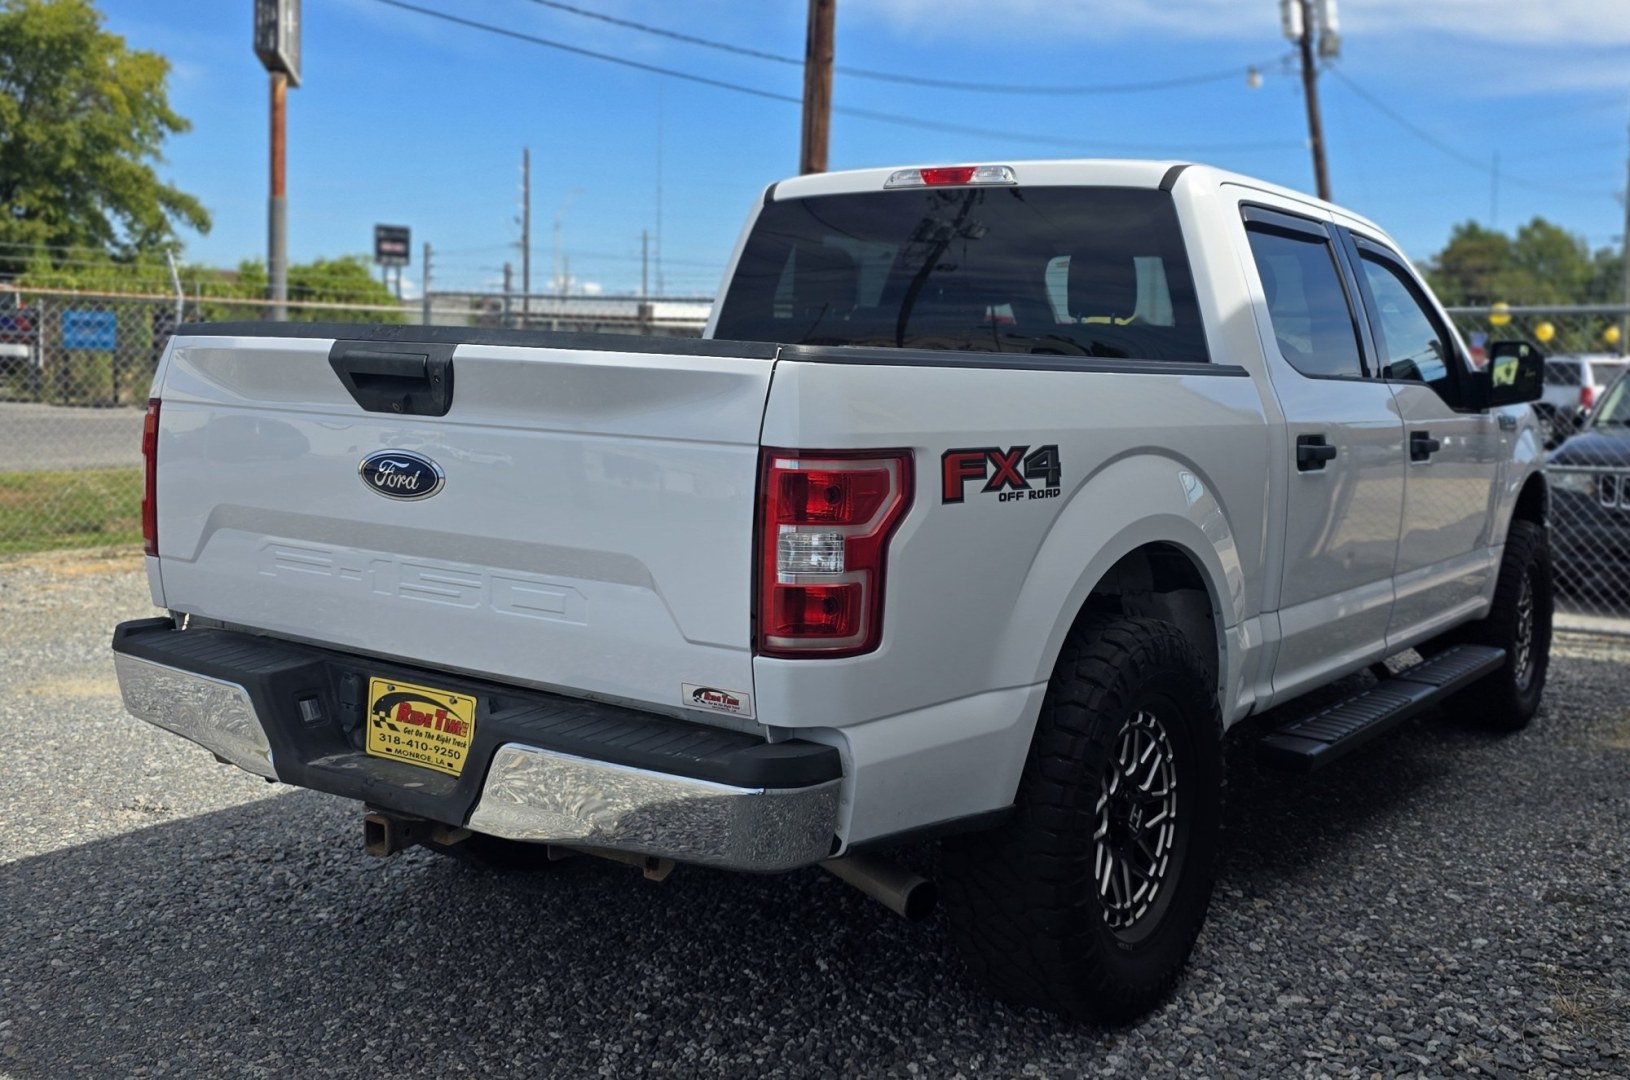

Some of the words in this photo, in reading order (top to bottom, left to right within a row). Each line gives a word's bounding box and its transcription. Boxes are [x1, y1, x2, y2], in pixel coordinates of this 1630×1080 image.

[374, 459, 421, 490] Ford
[940, 445, 1061, 505] FX4
[998, 490, 1025, 502] OFF
[1028, 488, 1061, 500] ROAD
[379, 733, 461, 760] 318-410-9250
[424, 731, 435, 741] The
[436, 733, 452, 745] Right
[452, 738, 468, 749] Track
[435, 757, 446, 766] LA
